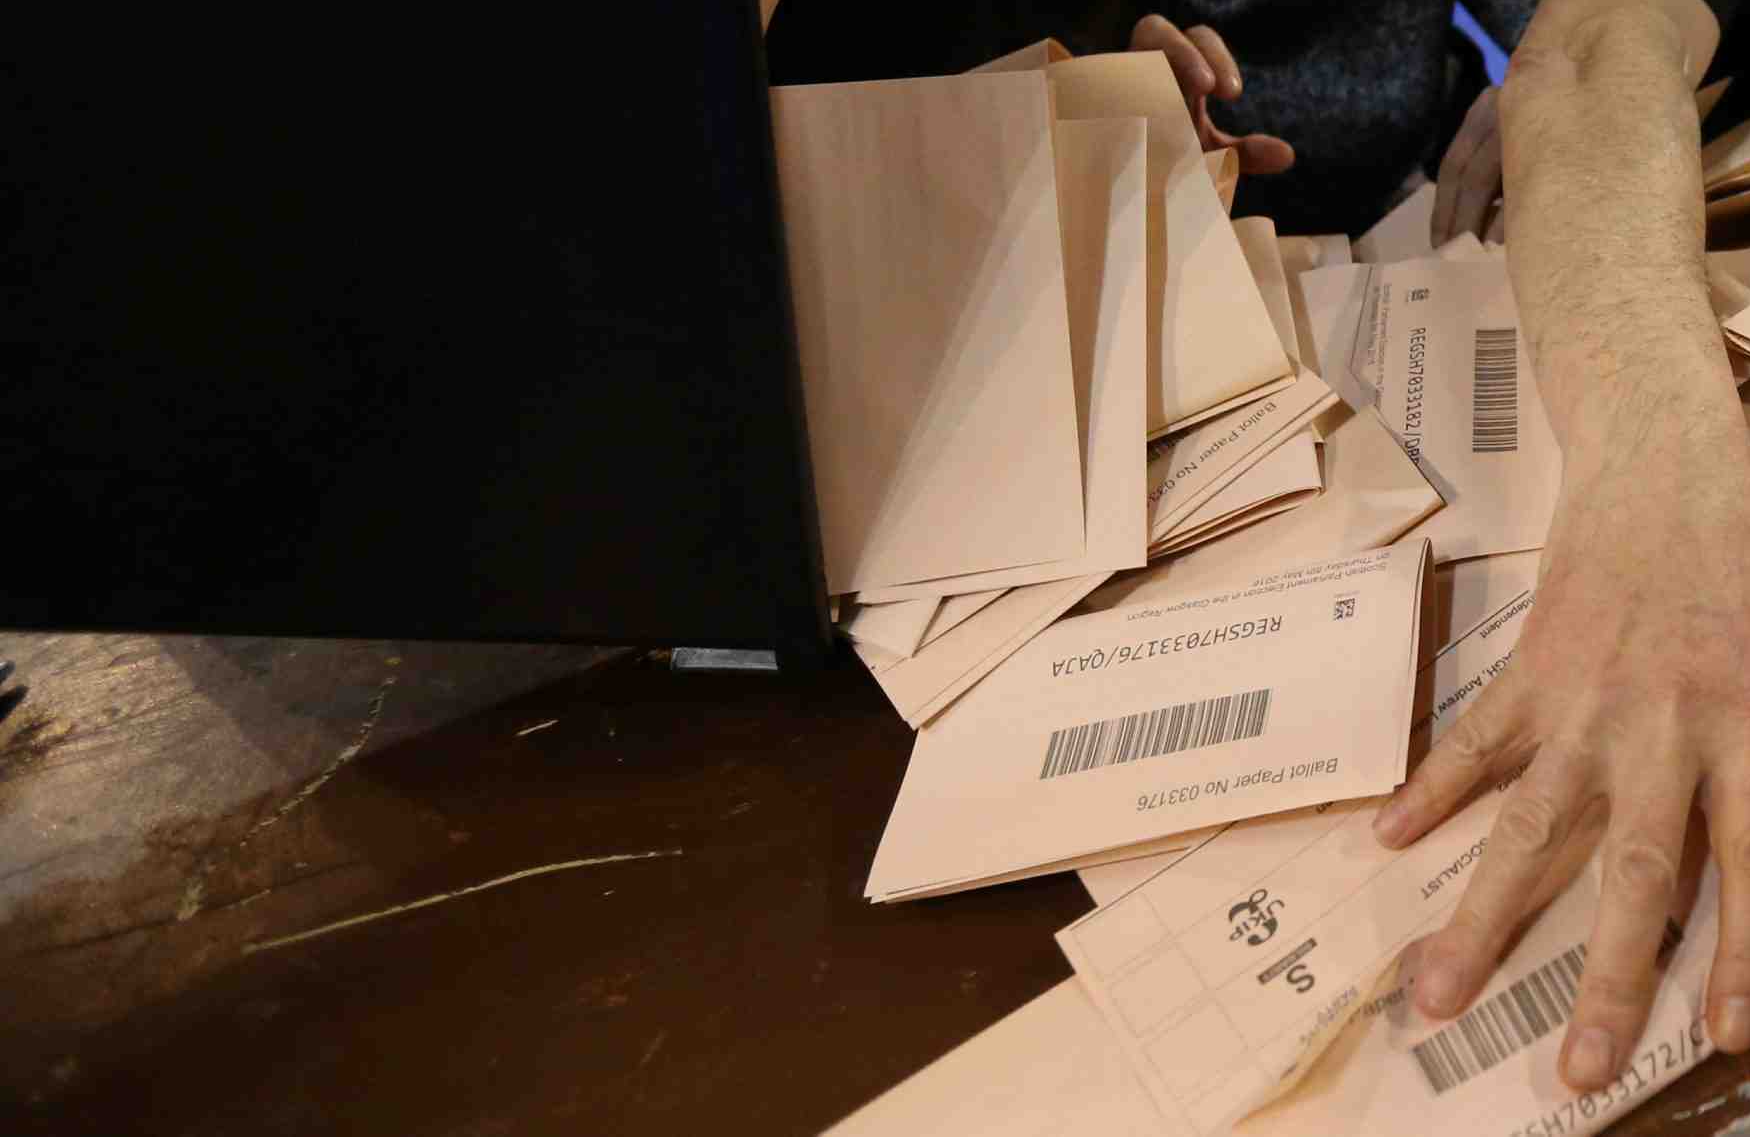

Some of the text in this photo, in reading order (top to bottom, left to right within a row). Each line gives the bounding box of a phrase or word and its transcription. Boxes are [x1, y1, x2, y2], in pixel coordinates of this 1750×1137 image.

[1239, 402, 1277, 432] Ballot
[1199, 430, 1240, 463] Paper
[1175, 461, 1199, 479] No
[1051, 614, 1283, 677] REGSH7033176/QAJA
[1437, 675, 1484, 714] Andrew
[1136, 757, 1339, 811] Ballot Paper No 033176
[1228, 898, 1286, 942] UKIP
